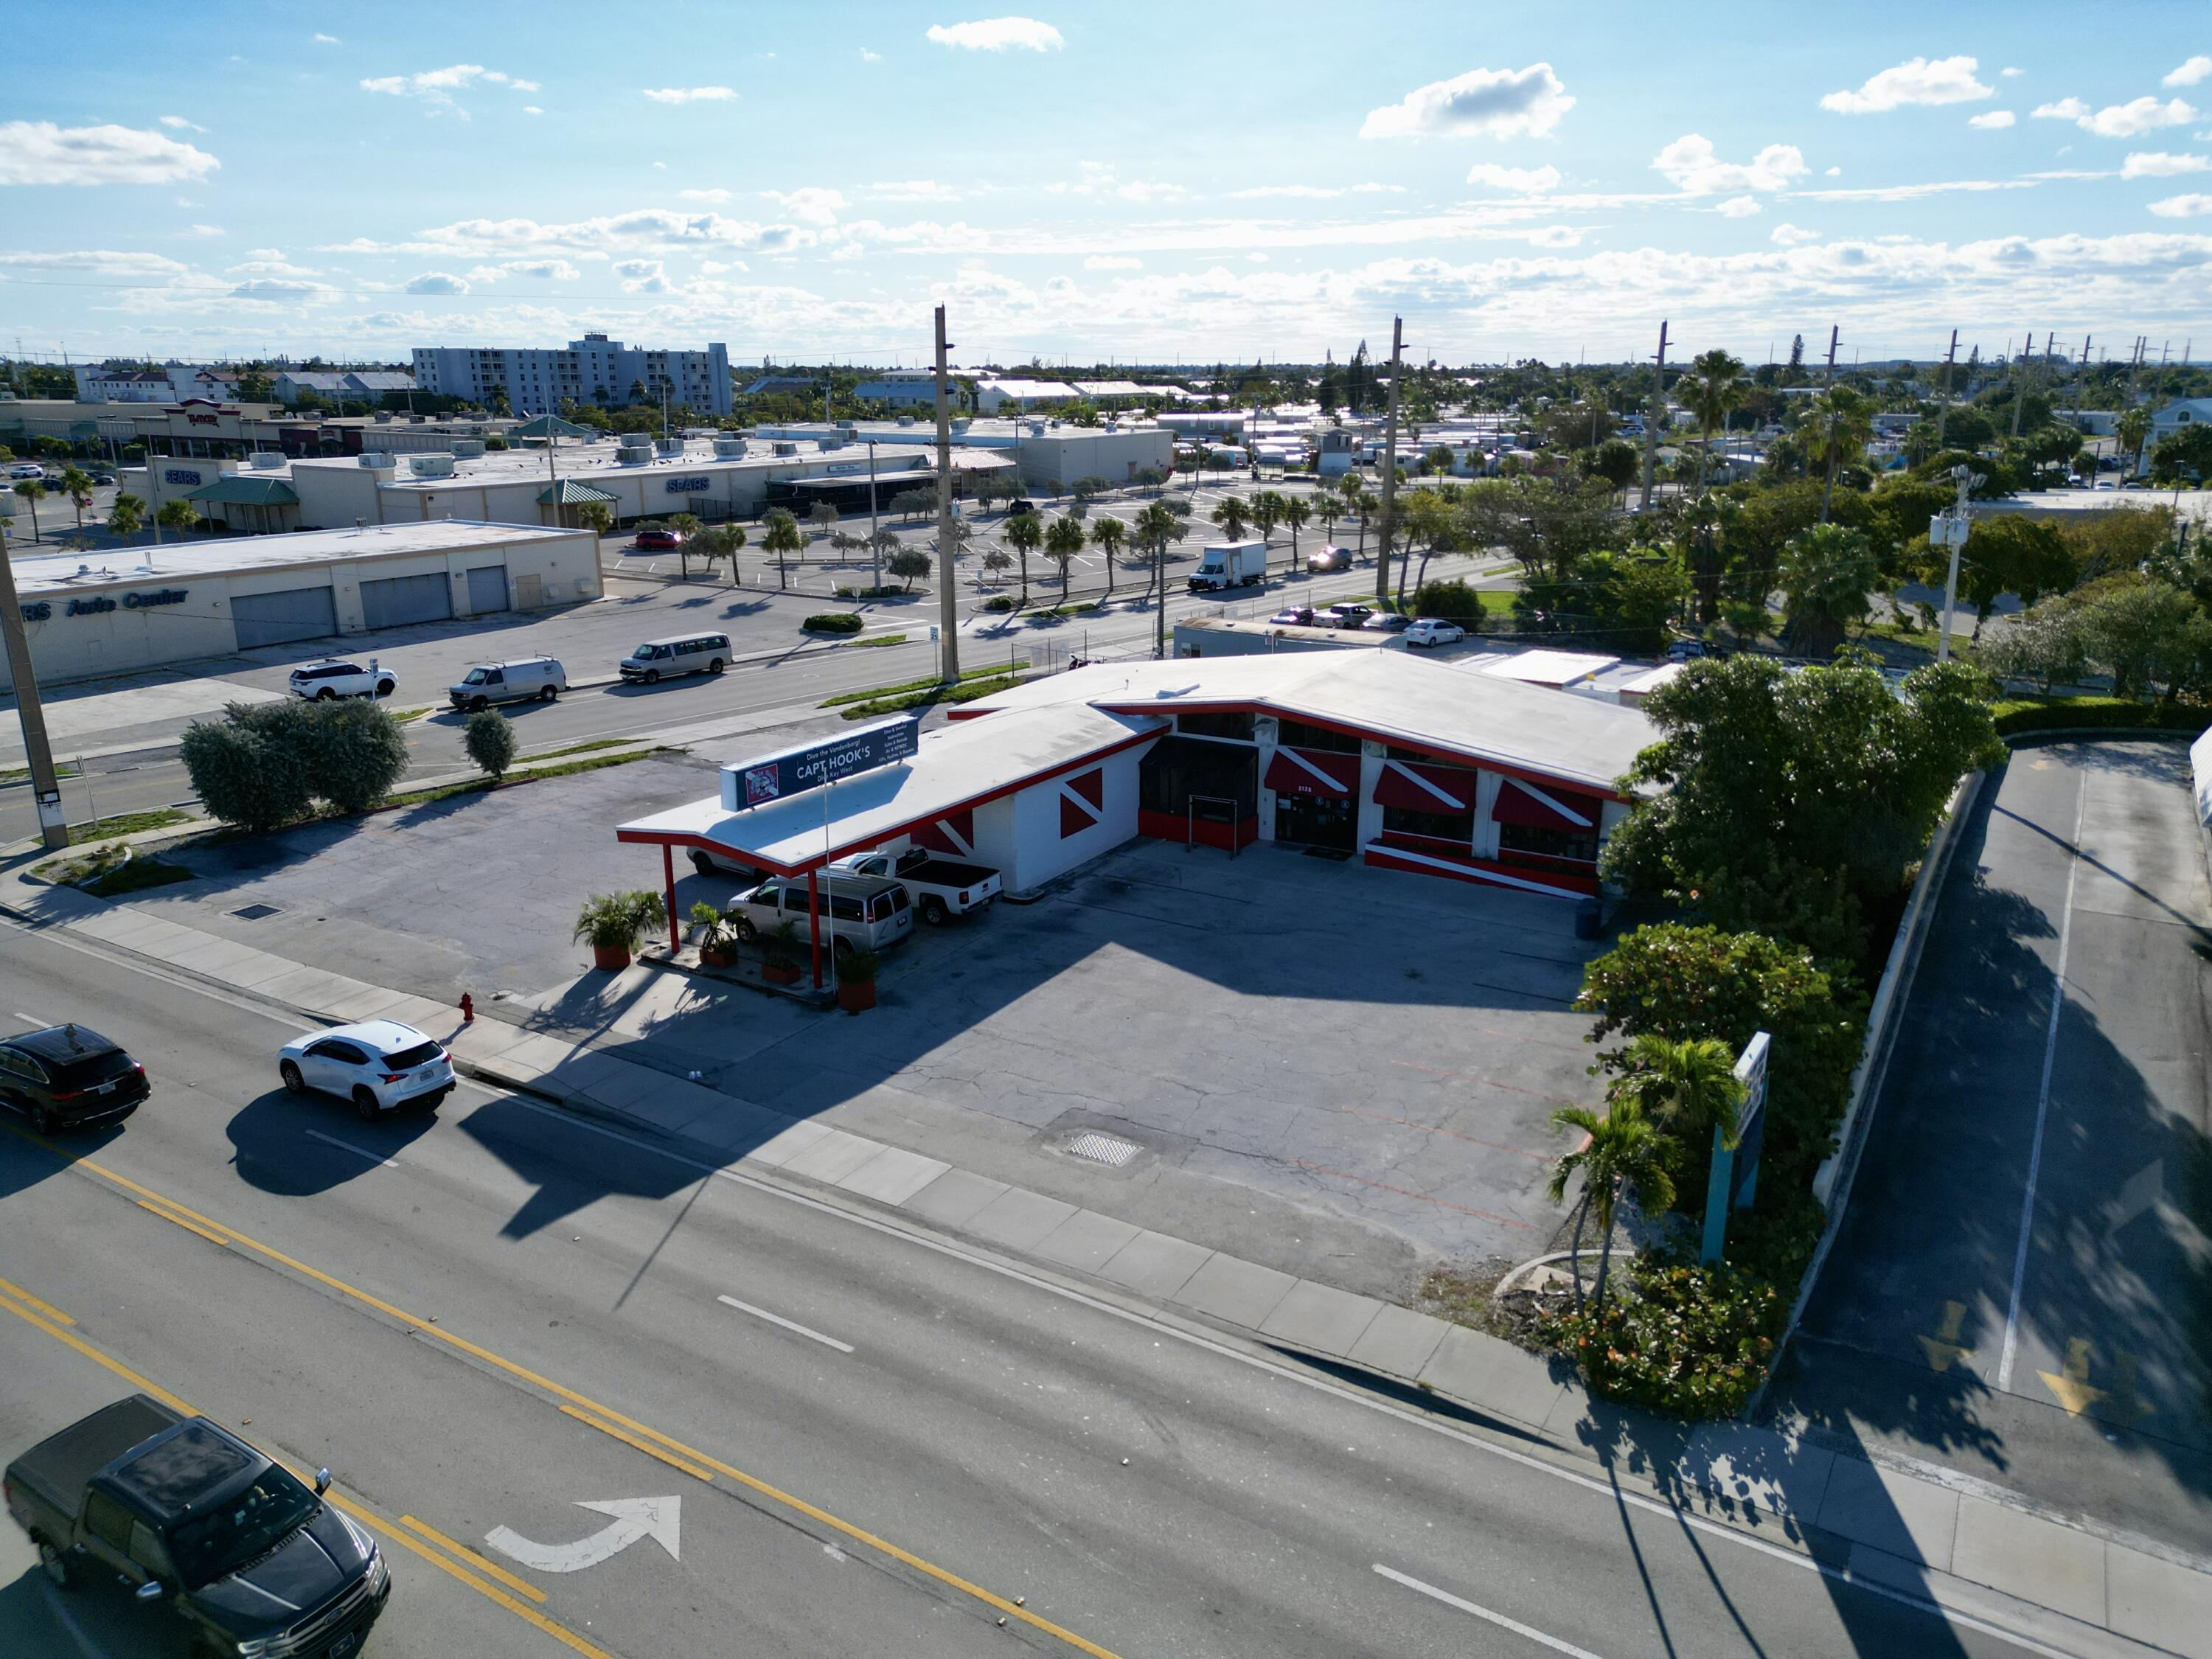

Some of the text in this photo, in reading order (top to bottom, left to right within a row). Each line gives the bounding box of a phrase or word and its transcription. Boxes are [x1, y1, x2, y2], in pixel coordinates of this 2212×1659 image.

[164, 470, 201, 486] SEARS
[666, 477, 710, 493] SEARS
[66, 597, 116, 617] Auto
[122, 589, 189, 609] Center
[796, 745, 871, 779] CAPT HOOK'S
[807, 752, 819, 761] Dive
[830, 771, 839, 779] Key
[840, 765, 853, 774] West
